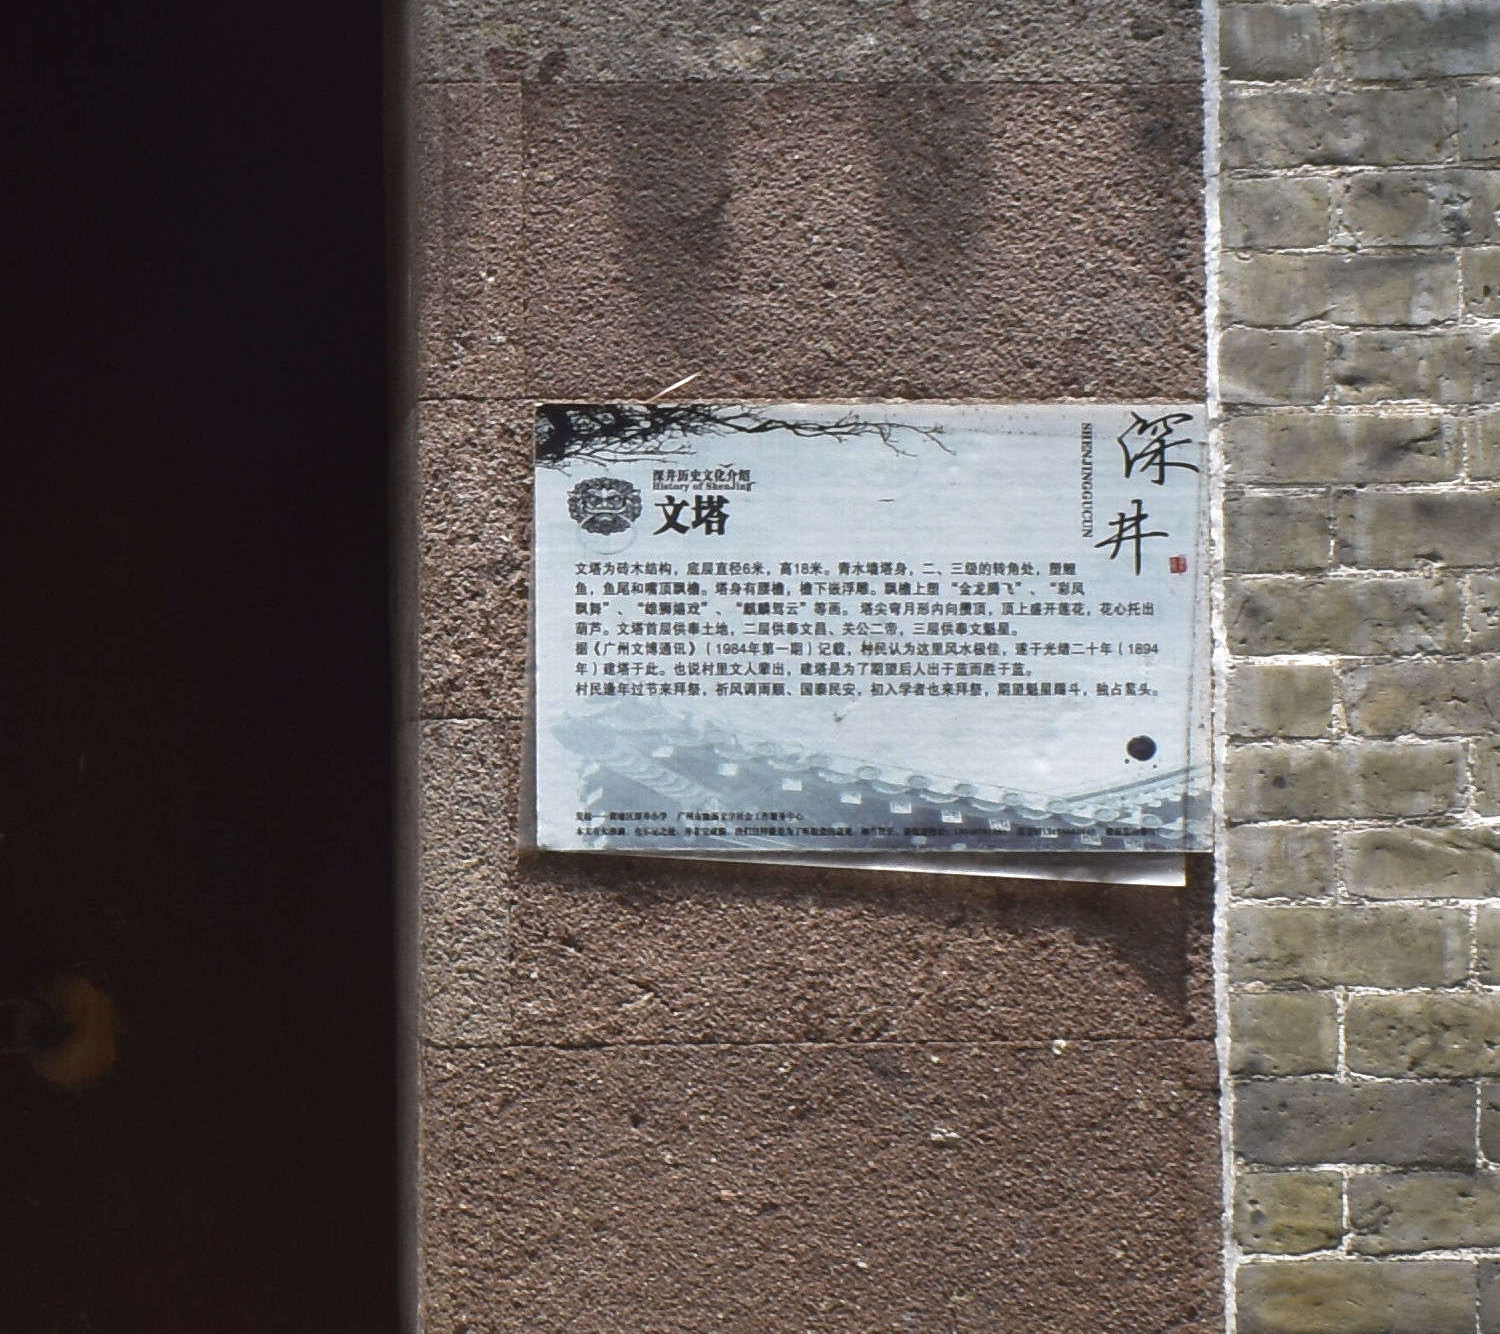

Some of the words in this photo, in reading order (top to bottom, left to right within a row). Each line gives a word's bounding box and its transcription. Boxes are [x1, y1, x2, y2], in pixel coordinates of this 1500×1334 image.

[652, 468, 752, 483] 深井历史文化介绍
[653, 482, 689, 492] History
[692, 482, 703, 491] of
[1081, 422, 1093, 538] SHENJINGGUCUN
[1094, 411, 1200, 576] 深井
[652, 494, 731, 536] 文塔
